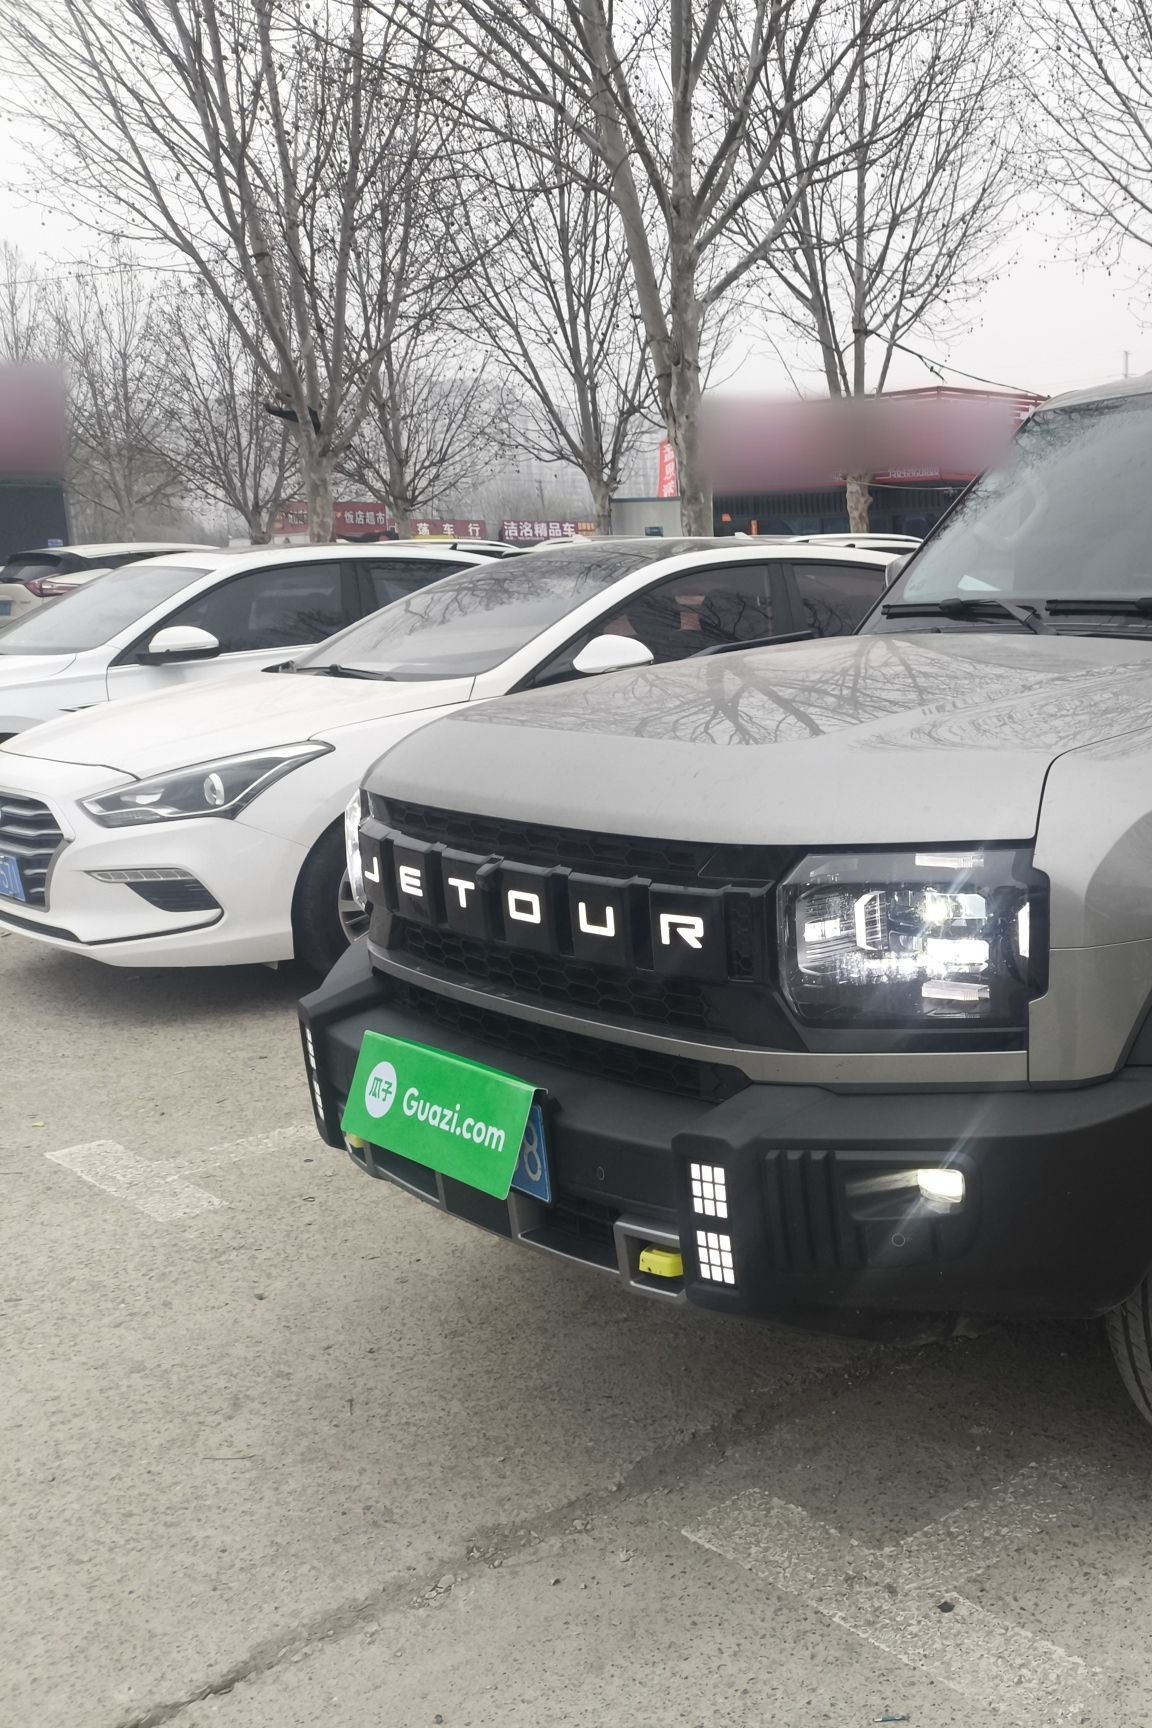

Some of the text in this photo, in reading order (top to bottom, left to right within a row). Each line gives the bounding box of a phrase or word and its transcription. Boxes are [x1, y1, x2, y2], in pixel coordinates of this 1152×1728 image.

[344, 510, 385, 525] 饭店超市
[364, 856, 705, 949] JETOUR
[368, 1076, 393, 1102] 瓜子
[402, 1087, 506, 1153] Guazi.com
